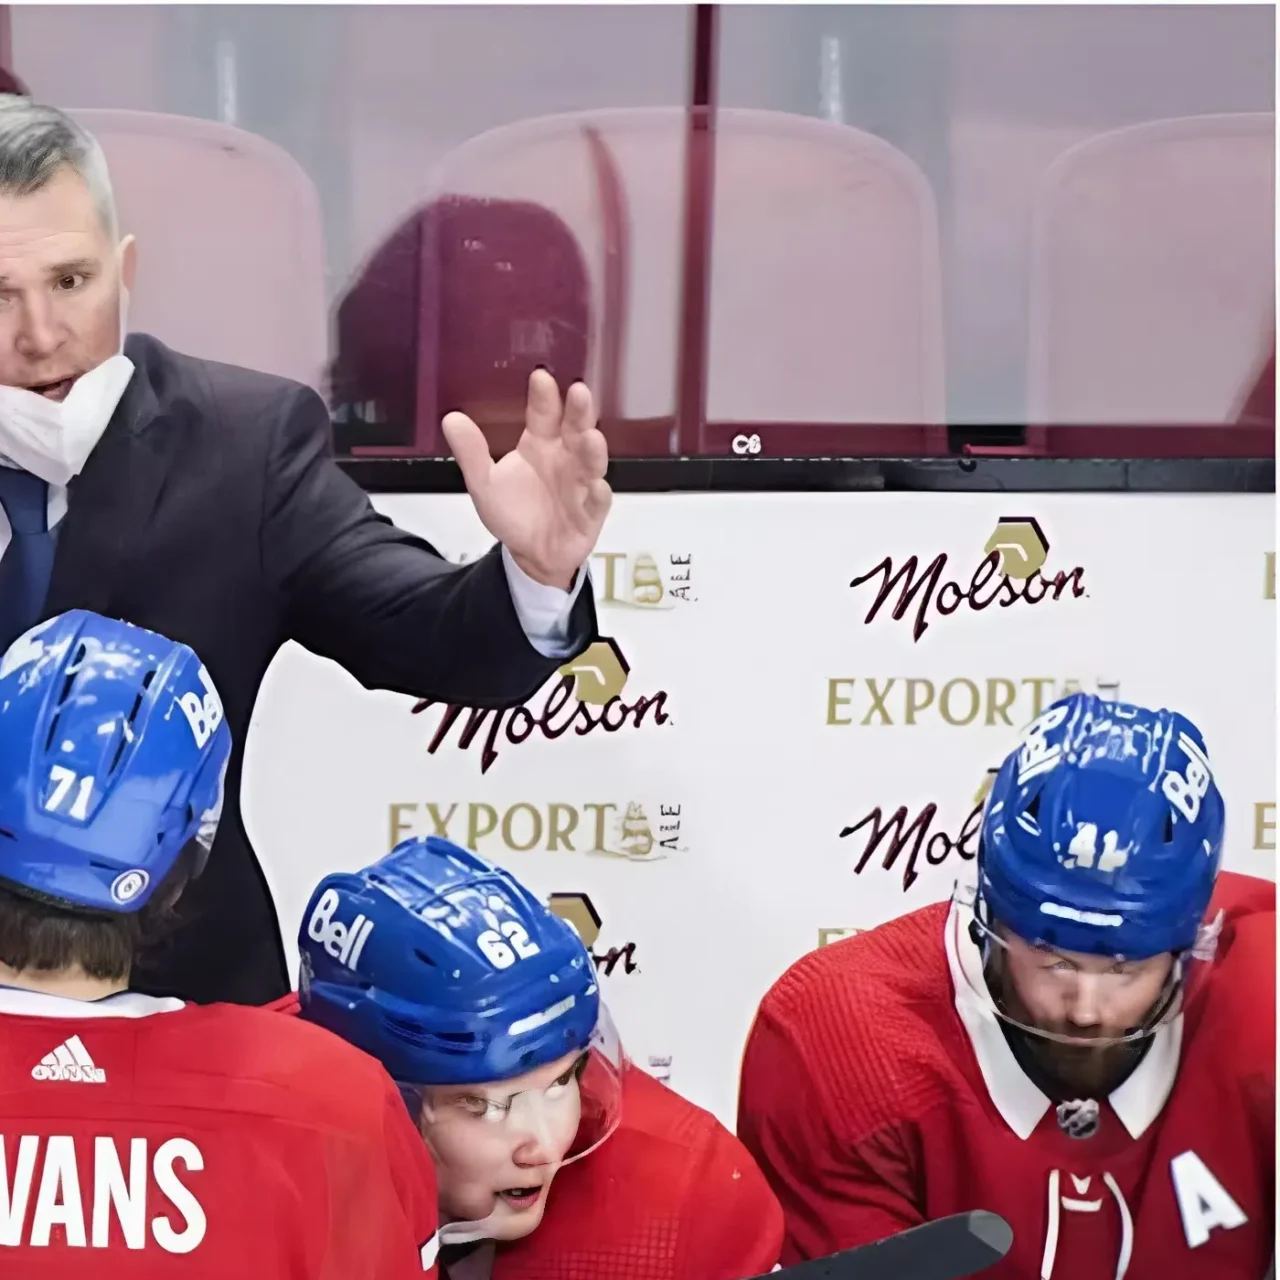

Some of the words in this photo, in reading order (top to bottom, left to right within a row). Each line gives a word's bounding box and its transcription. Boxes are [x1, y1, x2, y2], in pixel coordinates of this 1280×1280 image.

[849, 547, 1085, 644] Molson
[410, 670, 670, 775] Molson
[44, 763, 96, 822] 71
[839, 801, 985, 893] Mol
[307, 887, 375, 972] Bell
[476, 921, 541, 970] 62
[1171, 1147, 1250, 1248] A
